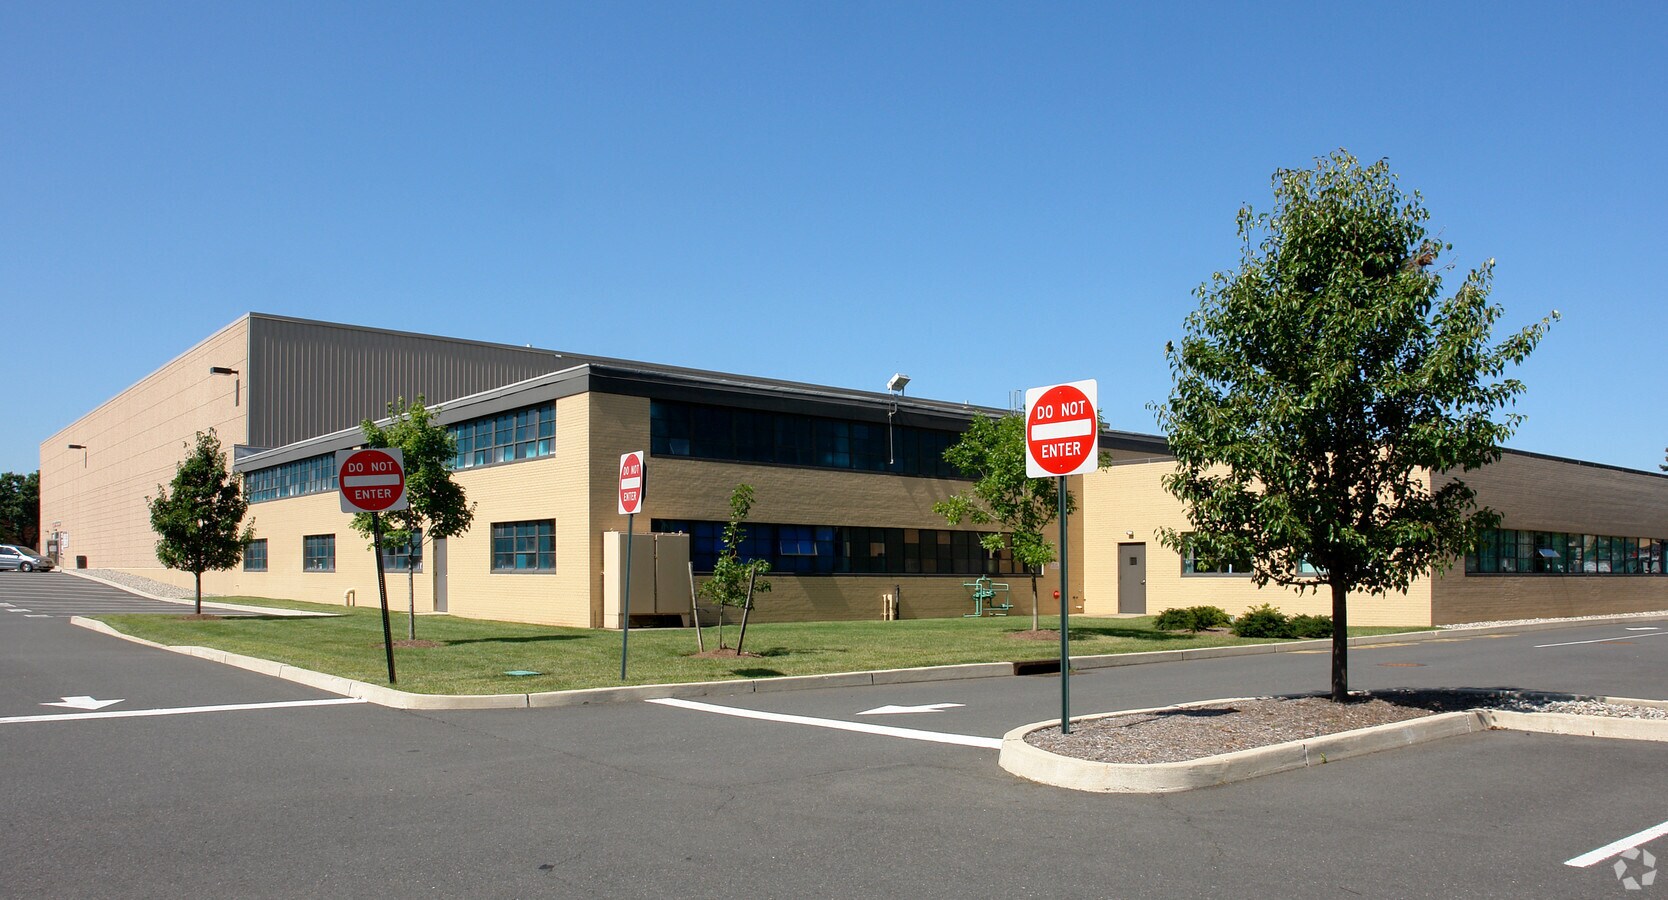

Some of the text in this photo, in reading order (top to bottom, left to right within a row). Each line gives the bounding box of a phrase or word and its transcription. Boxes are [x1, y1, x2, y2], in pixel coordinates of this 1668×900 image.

[1037, 400, 1086, 420] DO NOT
[1042, 441, 1081, 459] ENTER
[348, 461, 393, 473] DO NOT
[355, 489, 392, 500] ENTER
